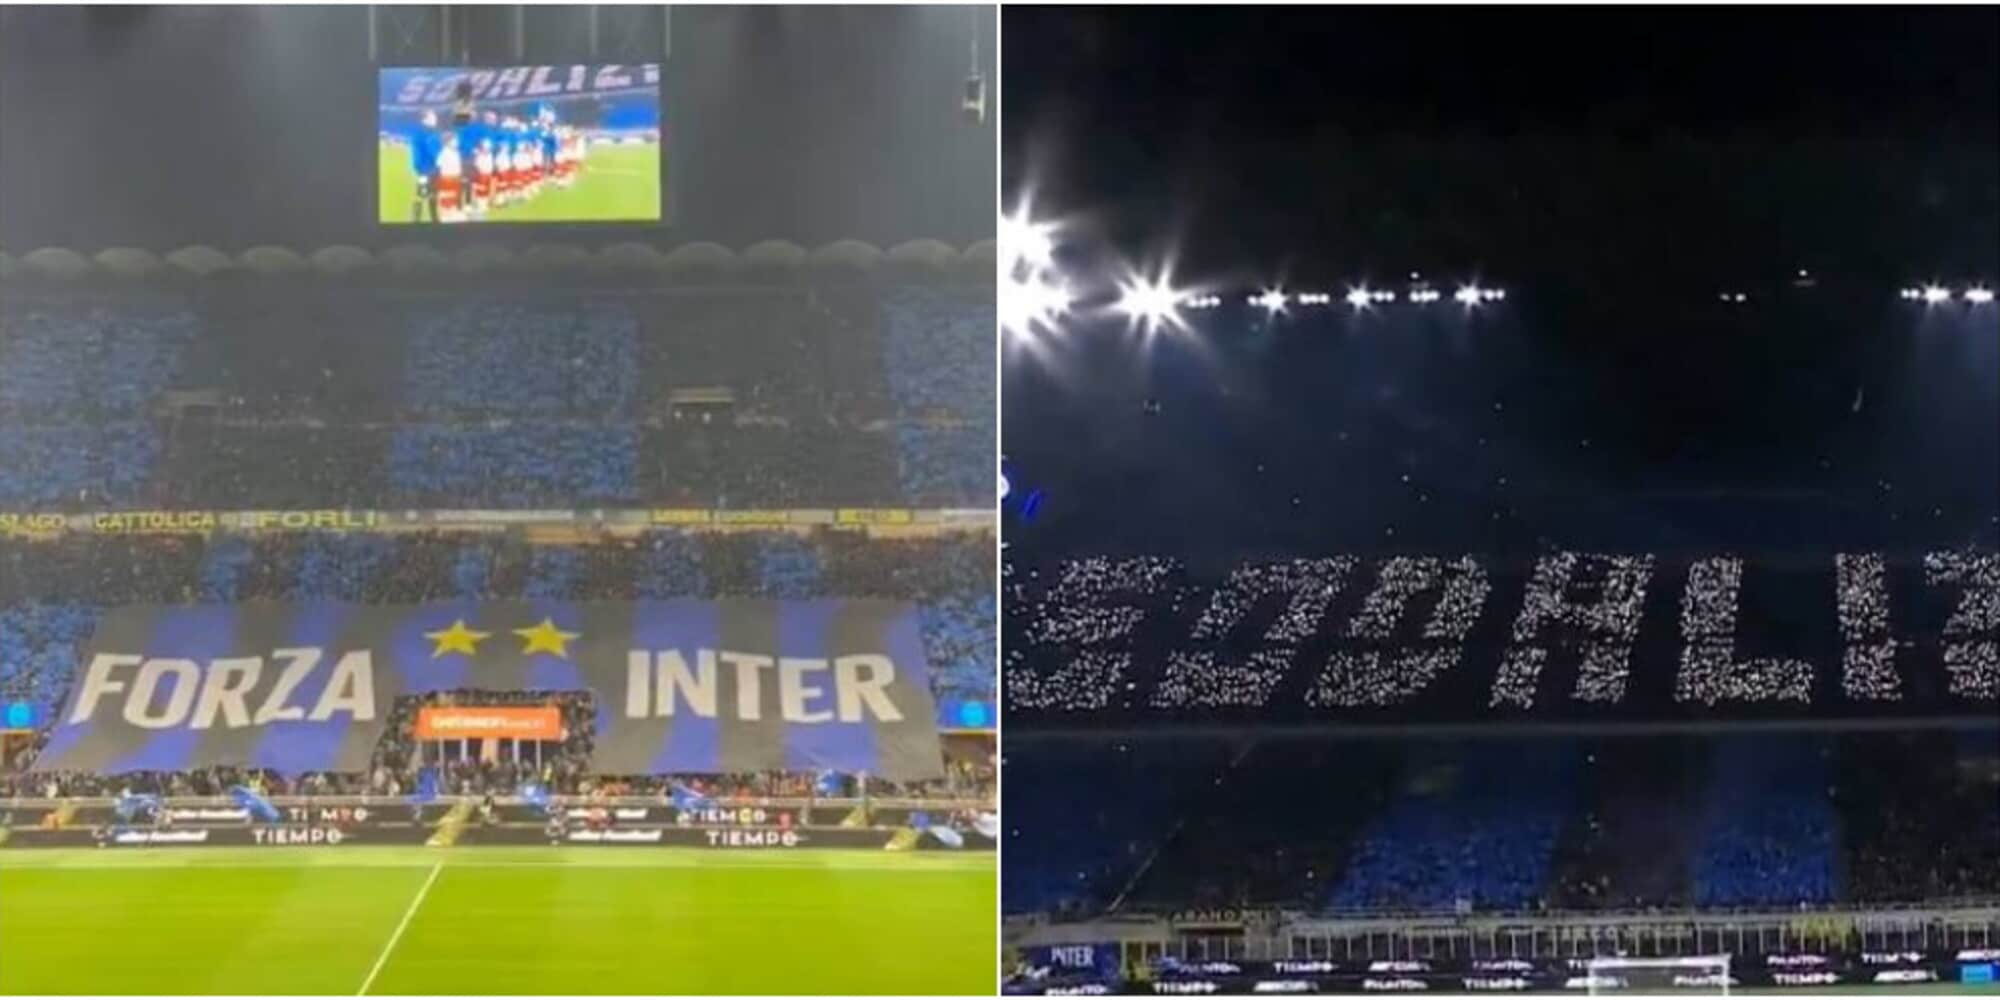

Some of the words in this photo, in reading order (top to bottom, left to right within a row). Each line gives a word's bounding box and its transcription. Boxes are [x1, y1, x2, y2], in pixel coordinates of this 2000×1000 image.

[95, 511, 216, 529] CATTOLICA
[69, 647, 375, 728] FORZA
[626, 648, 904, 723] INTER
[253, 828, 344, 844] TIEMPO
[706, 829, 799, 846] TIEMPO
